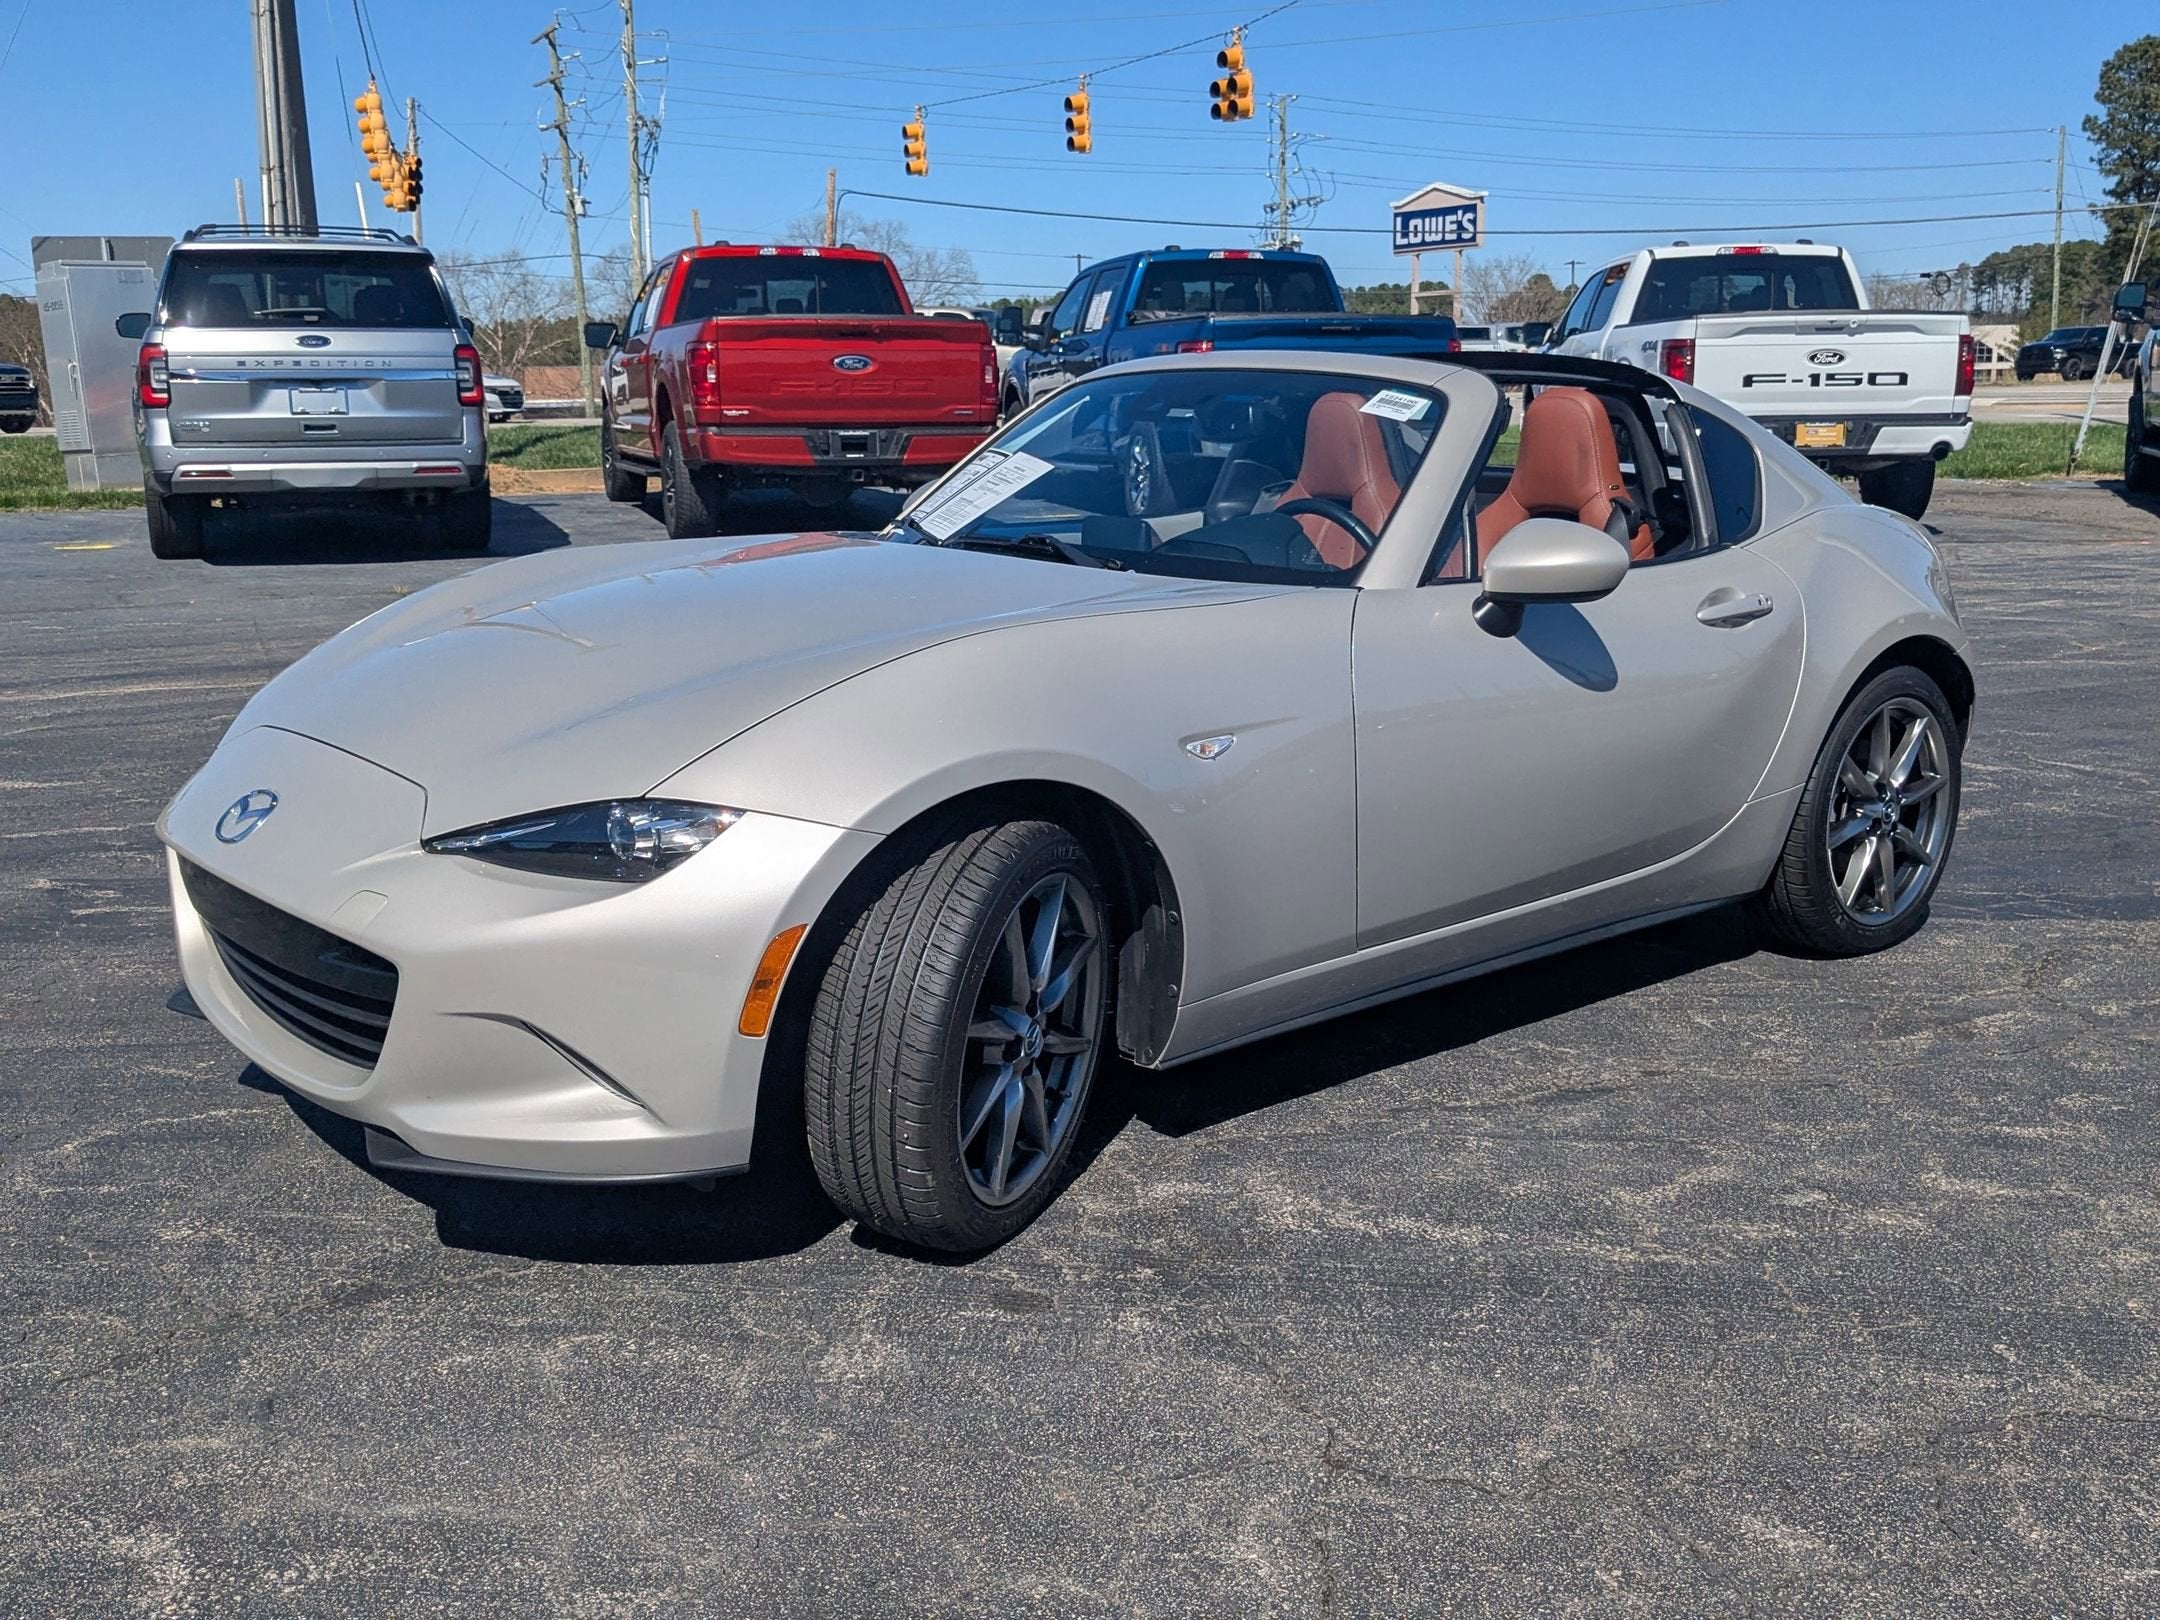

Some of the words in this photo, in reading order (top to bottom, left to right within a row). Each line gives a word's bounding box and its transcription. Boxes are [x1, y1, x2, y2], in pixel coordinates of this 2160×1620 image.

[1395, 209, 1475, 246] LOWE'S
[236, 360, 392, 368] EXPEDITION
[1813, 352, 1839, 364] Ford
[769, 378, 937, 396] F-150
[1742, 371, 1909, 388] F-150
